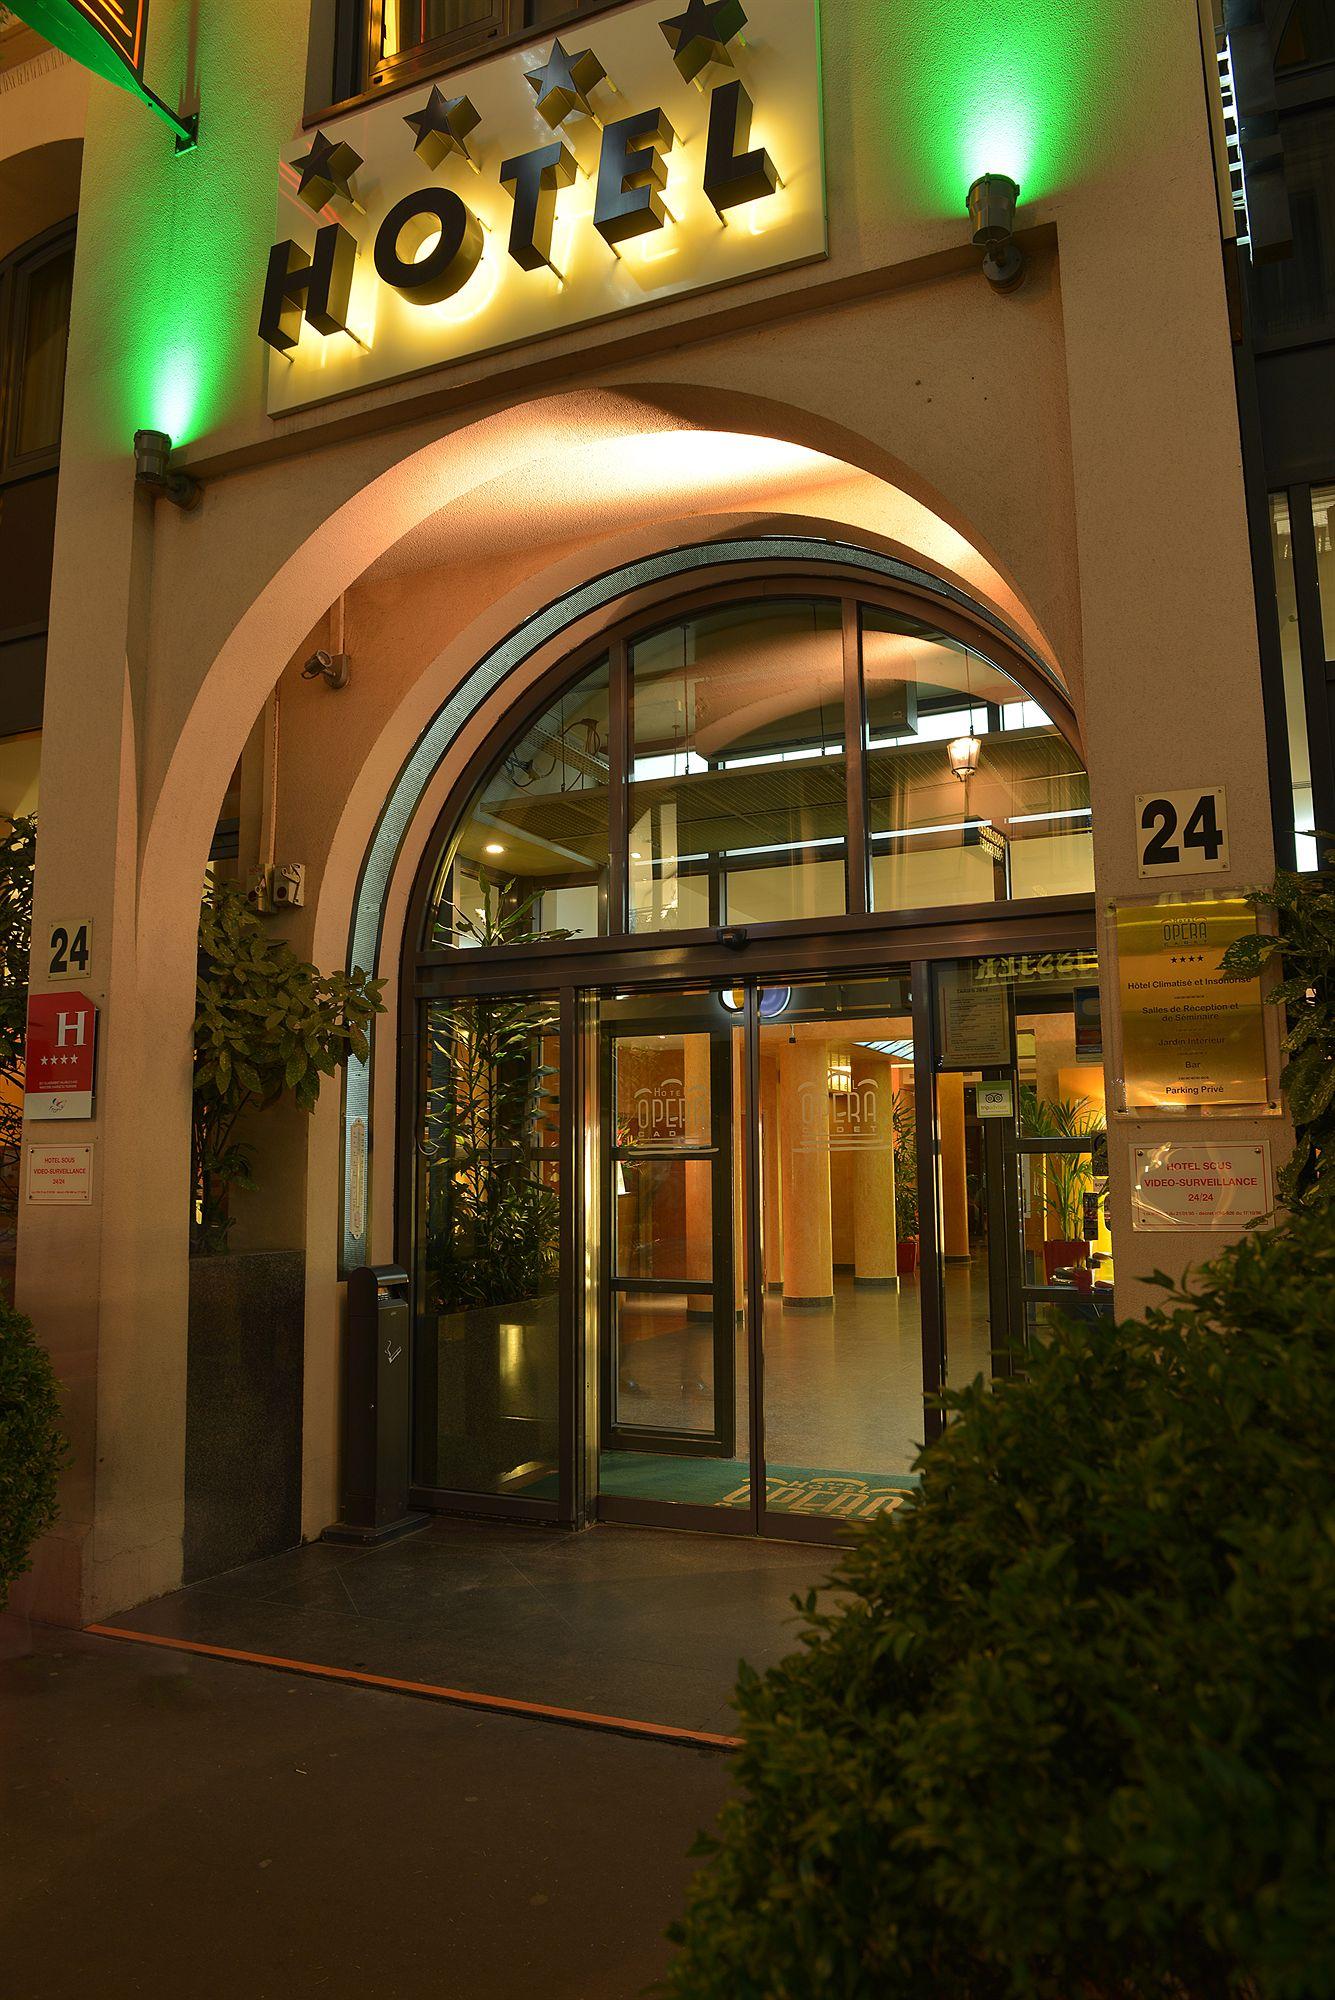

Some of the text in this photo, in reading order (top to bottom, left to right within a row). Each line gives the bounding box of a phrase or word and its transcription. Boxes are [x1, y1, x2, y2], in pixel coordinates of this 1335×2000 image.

[258, 80, 776, 350] HOTEL
[1142, 795, 1223, 865] 24
[1164, 922, 1208, 941] OPERA
[49, 925, 89, 974] 24
[1127, 980, 1151, 990] Hôtel
[1152, 978, 1193, 989] Climatisé
[1194, 979, 1203, 987] et
[1142, 1006, 1168, 1014] Salles
[1170, 1005, 1181, 1013] de
[1230, 1002, 1239, 1010] et
[1175, 1013, 1219, 1022] Séminaire
[54, 1010, 89, 1048] H
[1158, 1038, 1186, 1046] Jardin
[1185, 1061, 1201, 1069] Bar
[1165, 1084, 1224, 1096] Parking Privé
[1166, 1160, 1232, 1171] HOTEL SOUS
[1144, 1177, 1258, 1188] VIDEO-SURVEILLANCE
[1188, 1193, 1214, 1202] 24/24
